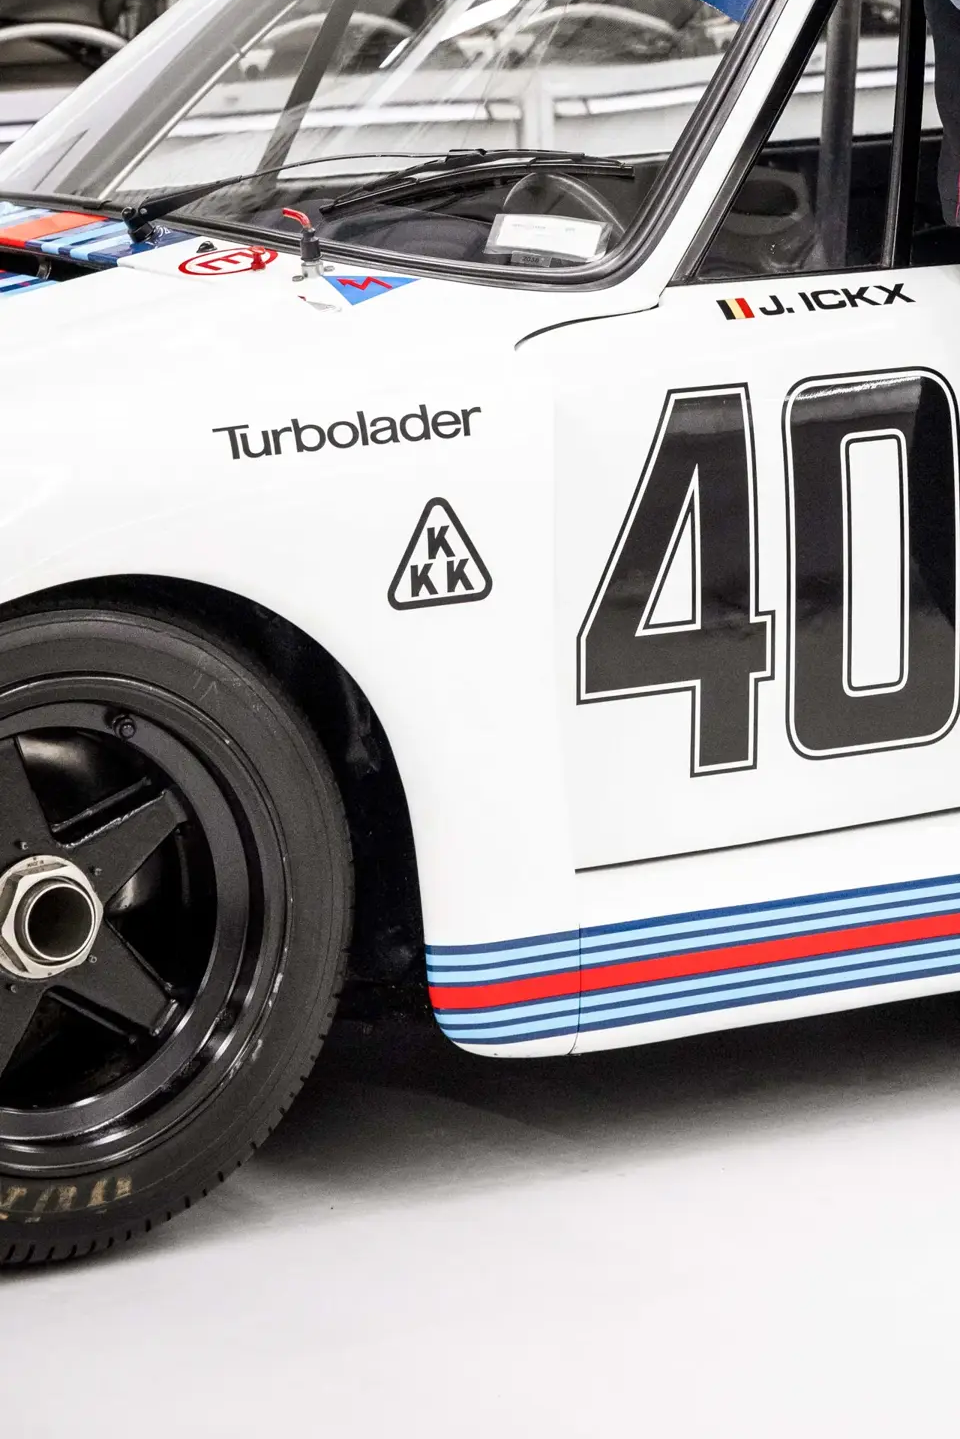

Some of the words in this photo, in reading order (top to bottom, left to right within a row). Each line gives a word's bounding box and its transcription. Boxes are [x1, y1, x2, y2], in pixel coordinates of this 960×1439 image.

[758, 294, 795, 316] J.
[798, 282, 916, 312] ICKX
[212, 403, 482, 460] Turbolader
